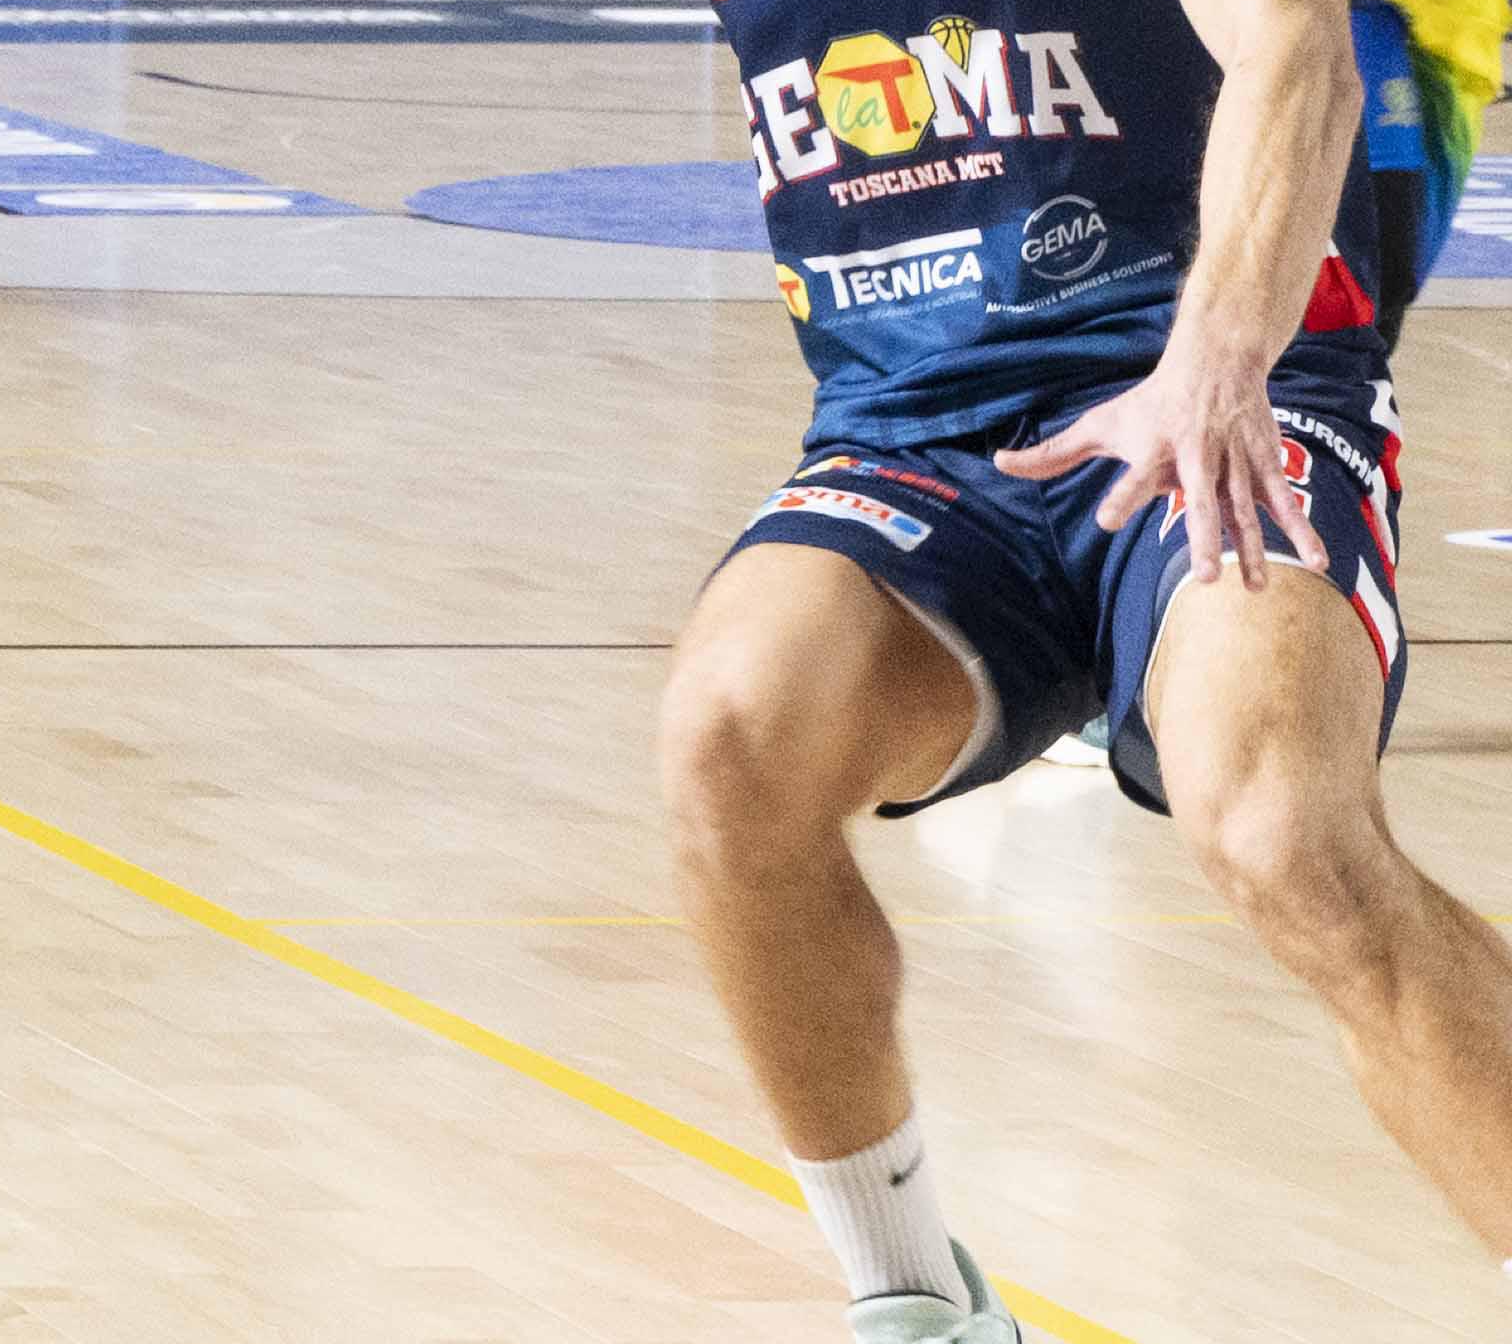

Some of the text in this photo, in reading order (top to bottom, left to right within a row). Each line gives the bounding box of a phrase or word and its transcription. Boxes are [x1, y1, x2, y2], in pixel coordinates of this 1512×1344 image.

[828, 152, 1005, 207] TOSCANA MCT
[1021, 212, 1108, 265] GEMA
[803, 227, 984, 310] TECNICA
